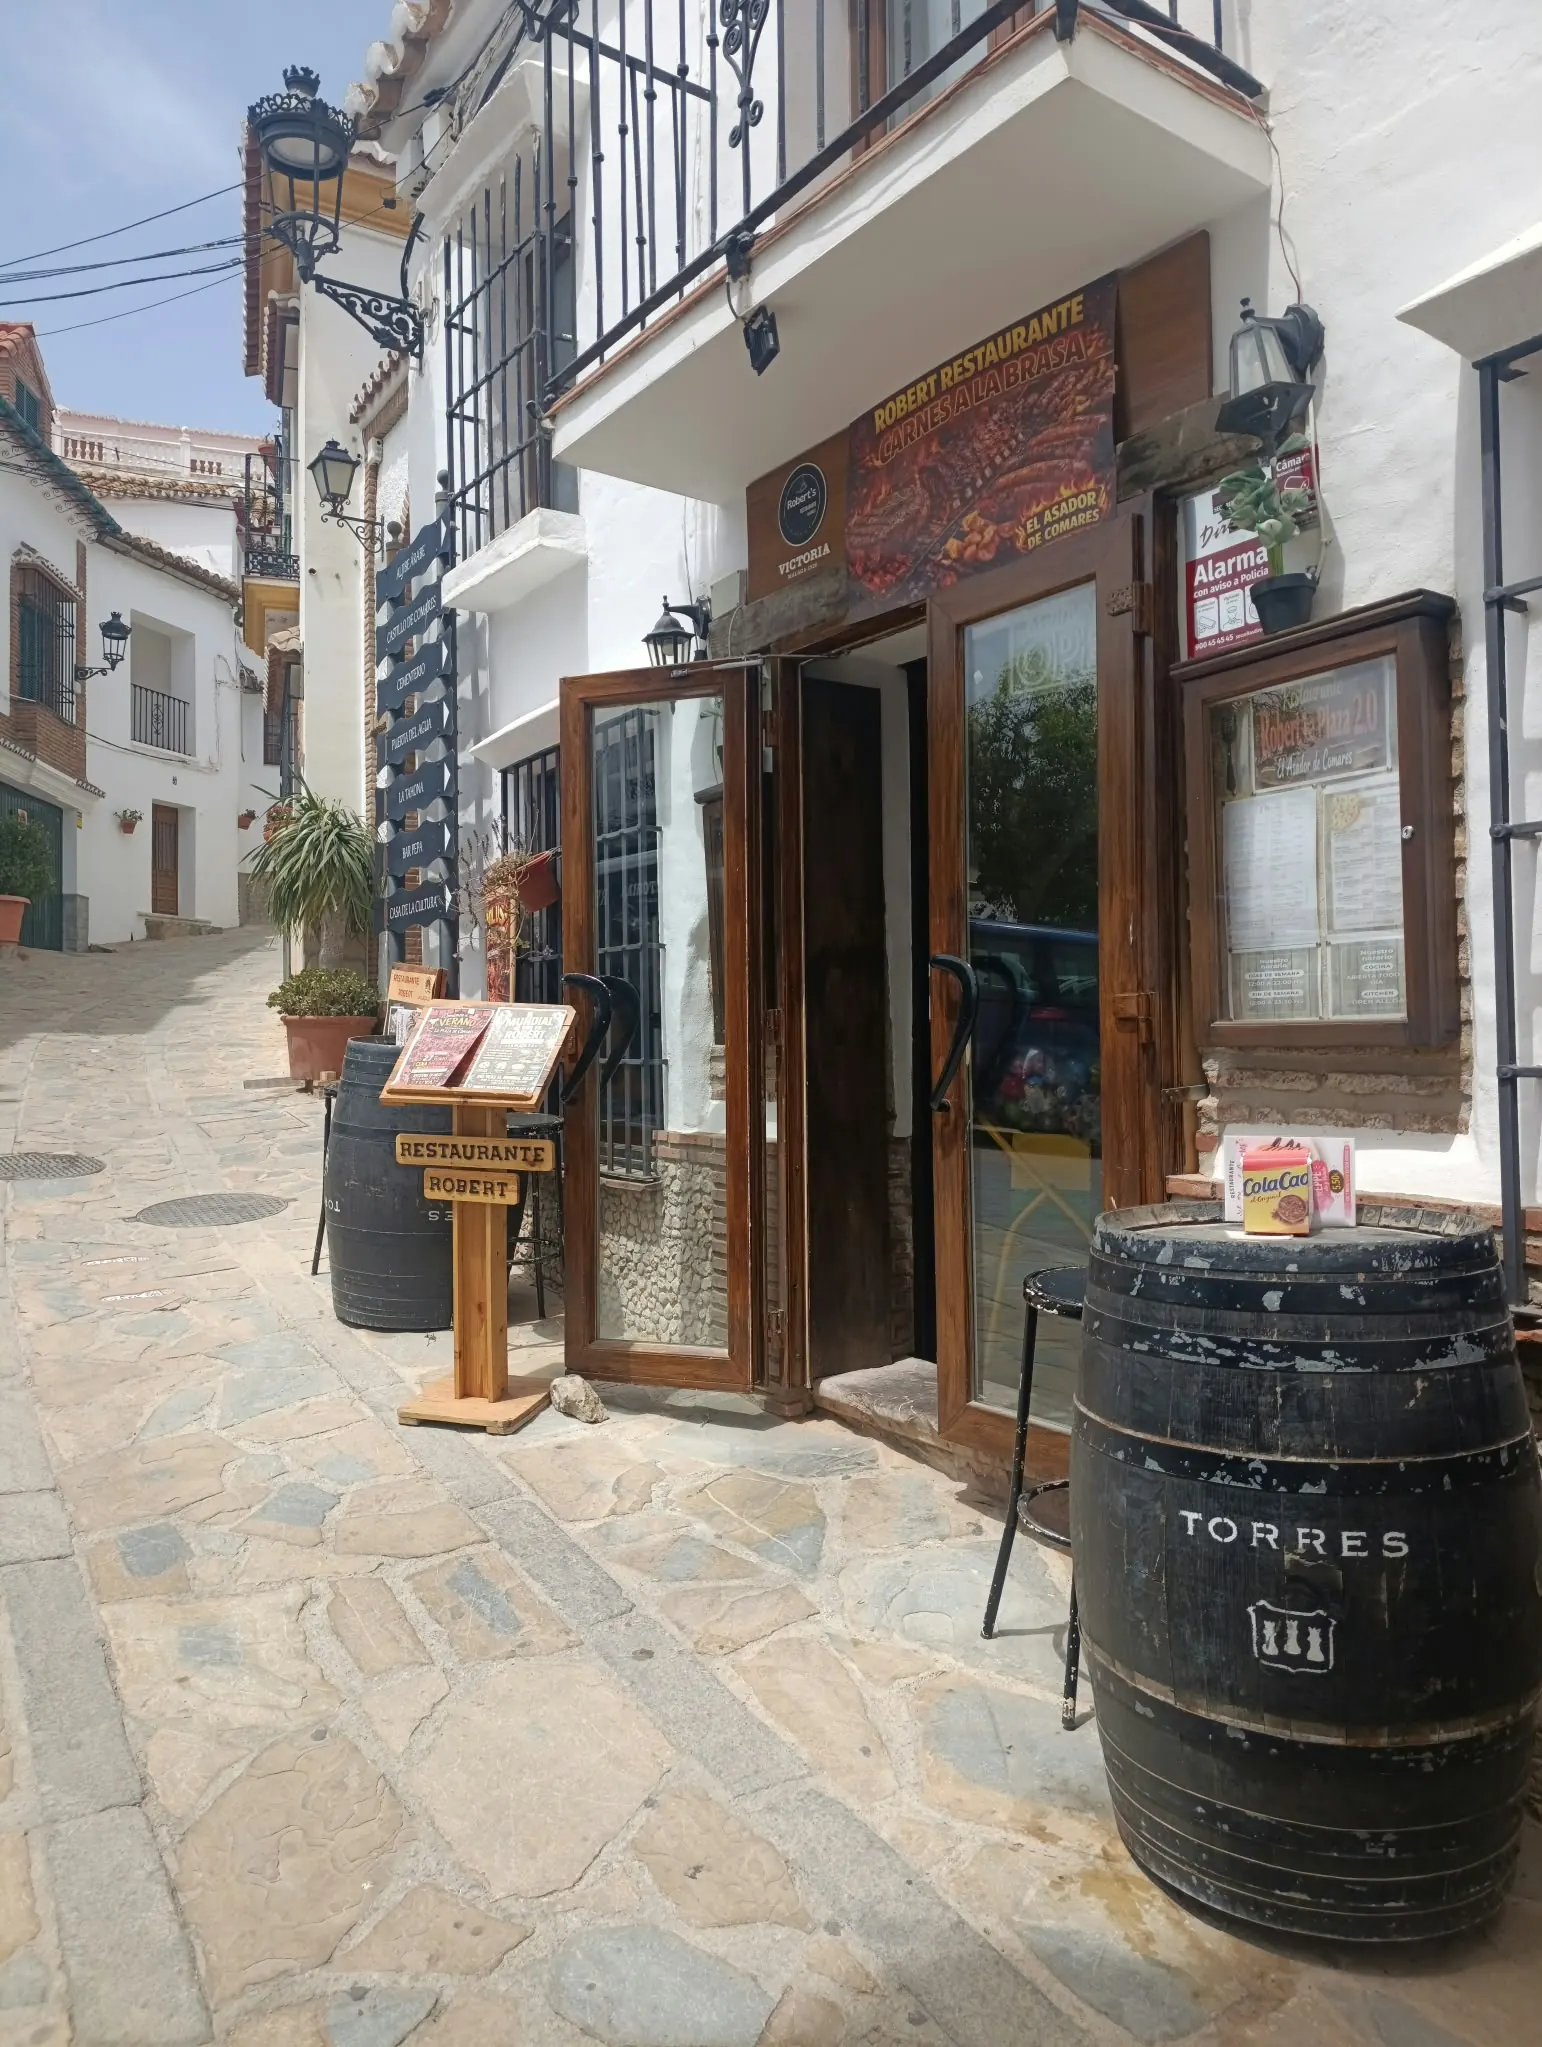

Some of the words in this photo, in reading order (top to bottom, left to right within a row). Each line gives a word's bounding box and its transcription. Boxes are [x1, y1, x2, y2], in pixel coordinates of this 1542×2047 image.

[874, 373, 938, 435] ROBERT
[940, 294, 1084, 392] RESTAURANTE
[879, 394, 952, 465] CARNES
[954, 385, 971, 416] A
[972, 370, 1002, 405] LA
[1003, 331, 1087, 391] BRASA
[787, 487, 817, 510] Robert's
[1026, 516, 1041, 534] EL
[1043, 491, 1097, 525] ASADOR
[1027, 532, 1042, 551] DE
[1044, 508, 1099, 540] COMARES
[779, 543, 831, 575] VICTORIA
[1194, 546, 1269, 587] Alarma
[1193, 588, 1209, 599] con
[1210, 580, 1232, 594] aviso
[1233, 577, 1239, 586] a
[1240, 566, 1269, 583] Policía
[387, 619, 407, 644] CASTILLO
[407, 613, 414, 629] DE
[414, 595, 437, 622] COMARES
[1195, 641, 1208, 651] 900
[1208, 638, 1216, 647] 45
[1217, 635, 1225, 644] 45
[1226, 633, 1234, 642] 45
[396, 662, 426, 691] CEMENTERIO
[391, 731, 409, 751] PUERTA
[408, 726, 417, 741] DEL
[418, 717, 432, 737] AGUA
[1312, 753, 1320, 771] de
[1322, 748, 1353, 771] Comares
[398, 790, 406, 804] LA
[402, 846, 411, 860] BAR
[412, 841, 423, 858] PEPA
[389, 905, 402, 919] CASA
[401, 903, 409, 916] DE
[409, 902, 415, 914] LA
[415, 896, 438, 912] CULTURA
[440, 1016, 477, 1028] VERANO
[503, 1029, 546, 1040] ROBERT
[505, 1015, 554, 1027] MUNDIAL
[400, 1142, 545, 1163] RESTAURANTE
[429, 1176, 508, 1197] ROBERT
[1228, 1160, 1236, 1199] RESTAURANTE
[1243, 1171, 1309, 1196] ColaCao
[1178, 1509, 1409, 1558] TORRES
